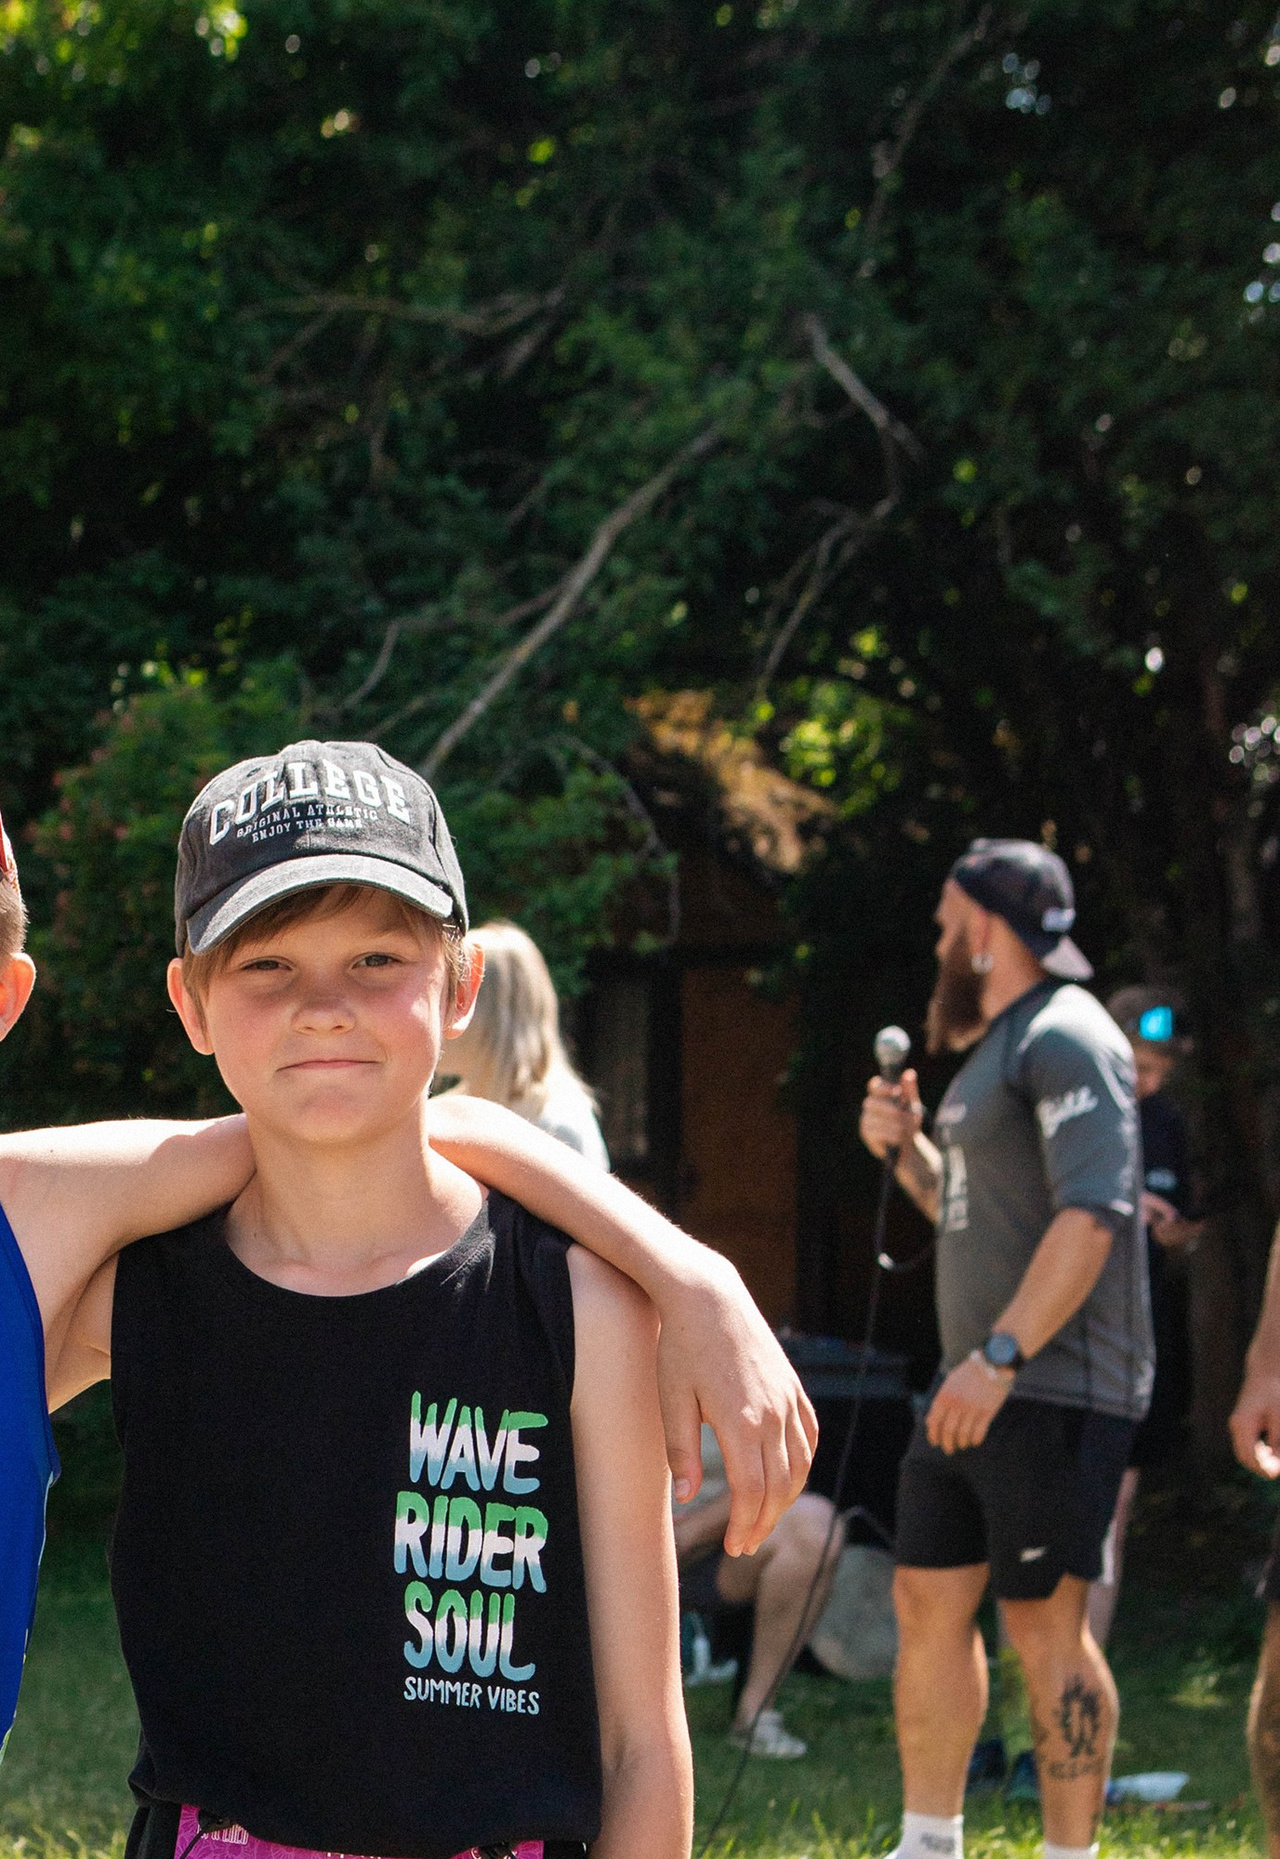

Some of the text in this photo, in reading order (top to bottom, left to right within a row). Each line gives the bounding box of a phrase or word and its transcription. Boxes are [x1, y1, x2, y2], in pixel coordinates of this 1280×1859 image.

[209, 759, 410, 846] COLLEGE
[236, 803, 378, 838] ORIGINAL ATHLETIC
[252, 817, 362, 843] ENJOY THE GAME
[409, 1390, 549, 1495] WAVE
[394, 1490, 549, 1593] RIDER
[404, 1580, 536, 1682] SOUL
[403, 1676, 540, 1715] SUMMER VIBES
